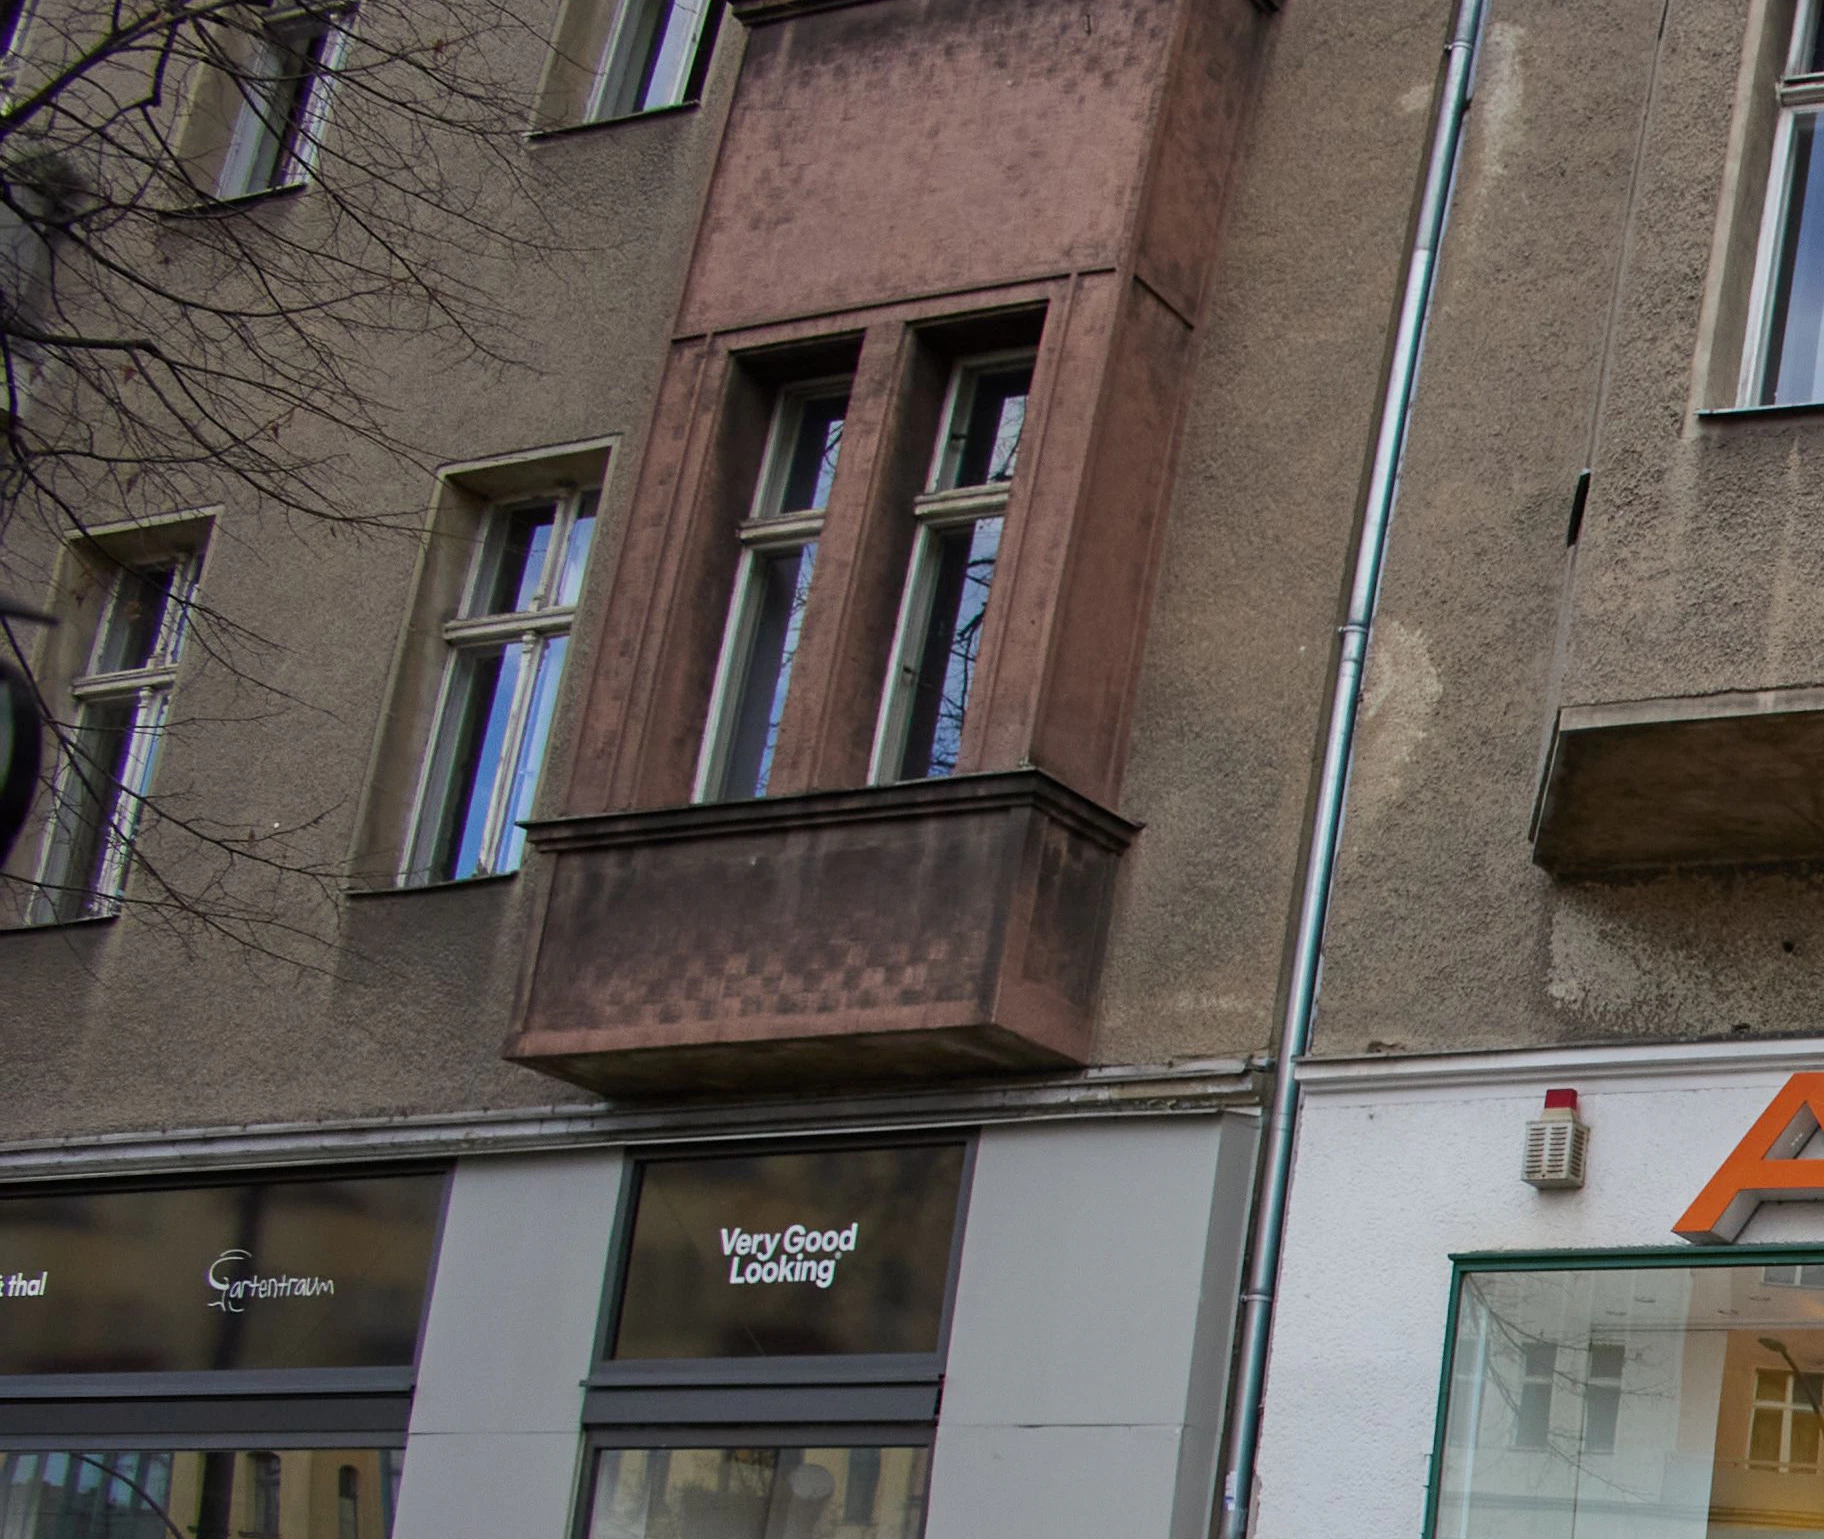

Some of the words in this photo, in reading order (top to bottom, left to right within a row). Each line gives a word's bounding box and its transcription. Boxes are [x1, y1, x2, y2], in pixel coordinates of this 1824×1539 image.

[720, 1227, 782, 1261] Very
[783, 1222, 859, 1254] Good
[8, 1271, 48, 1298] thal
[729, 1252, 837, 1288] Looking
